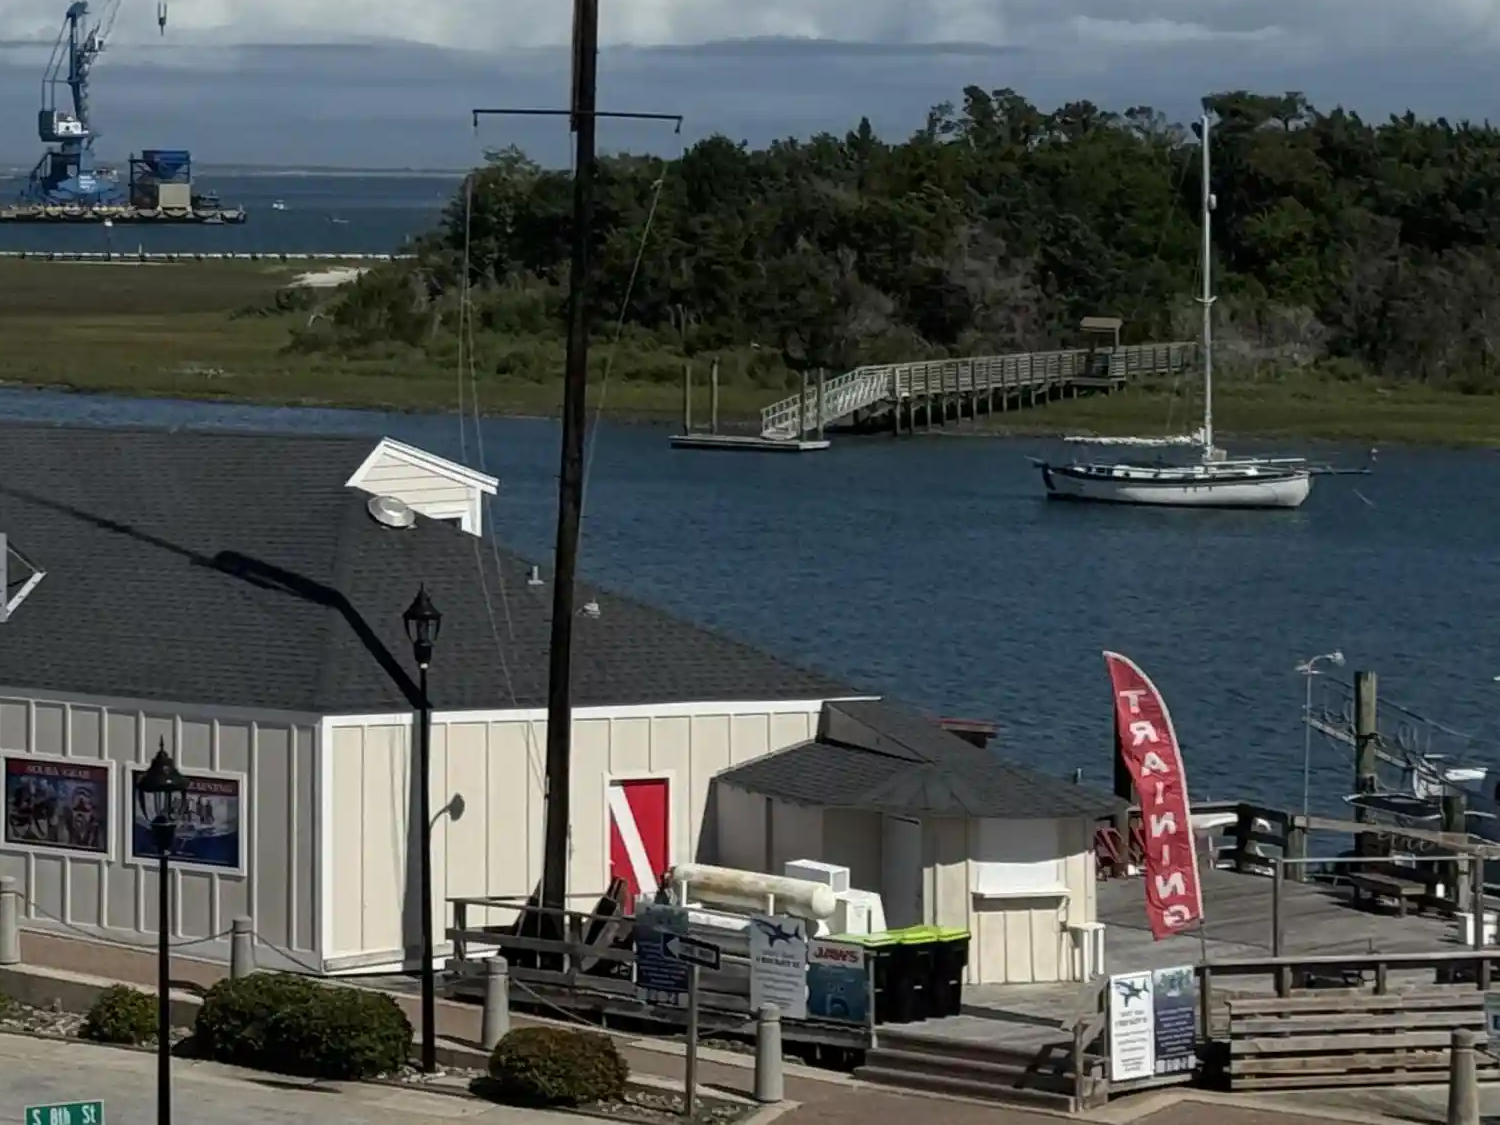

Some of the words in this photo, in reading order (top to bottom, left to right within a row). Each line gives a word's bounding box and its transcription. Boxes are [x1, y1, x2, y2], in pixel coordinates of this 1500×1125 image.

[24, 764, 60, 776] SCUBA
[813, 946, 859, 964] JAWS
[32, 1108, 41, 1125] S
[50, 1106, 71, 1125] 8th
[81, 1104, 97, 1124] St
